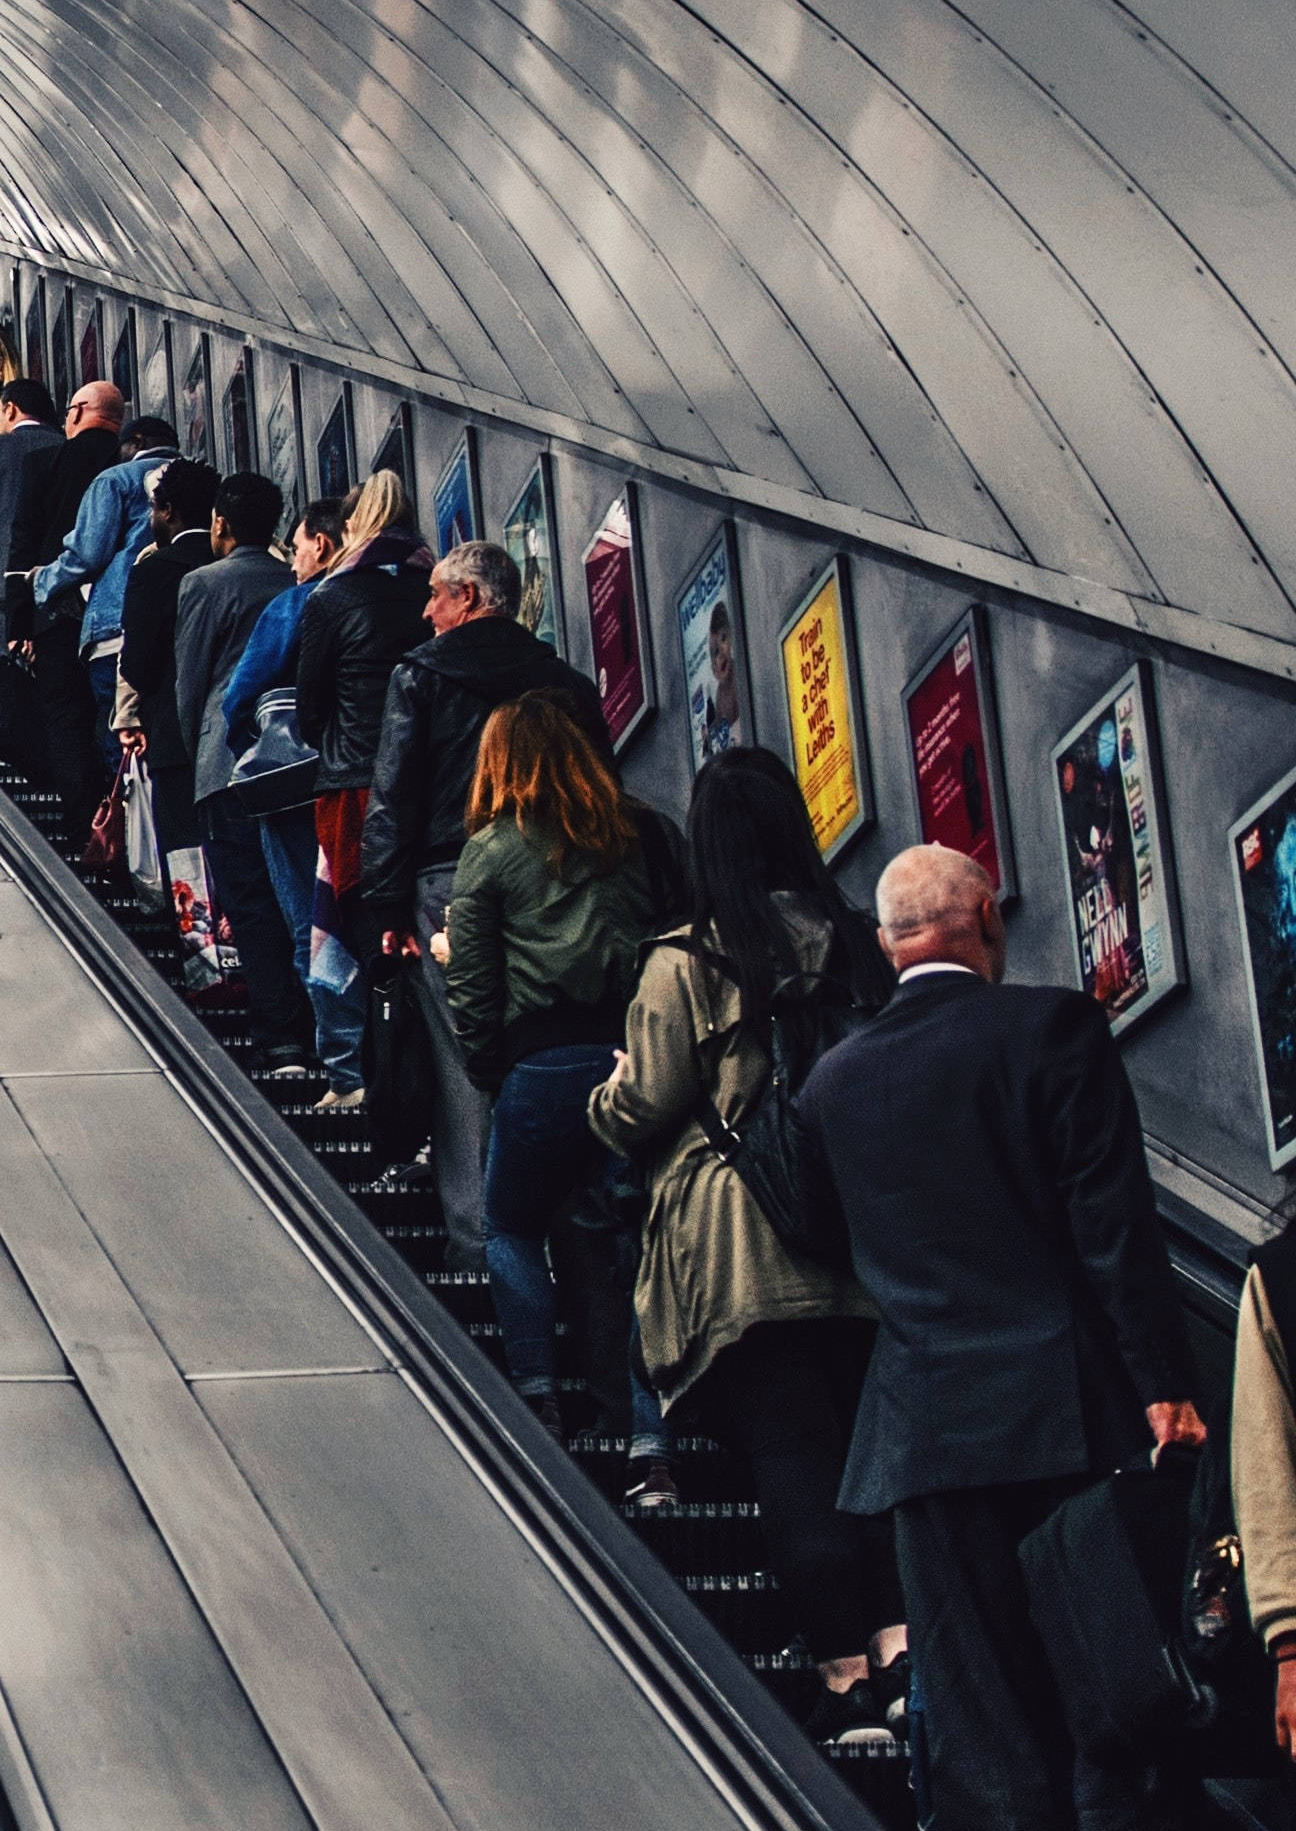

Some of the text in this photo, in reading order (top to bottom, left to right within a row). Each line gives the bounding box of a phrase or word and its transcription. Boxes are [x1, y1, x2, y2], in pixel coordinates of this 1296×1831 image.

[799, 618, 822, 657] Train
[801, 643, 825, 684] to be
[808, 696, 828, 735] with
[806, 720, 835, 767] Leiths
[1077, 878, 1112, 936] NELL
[1082, 901, 1129, 976] GWYNN
